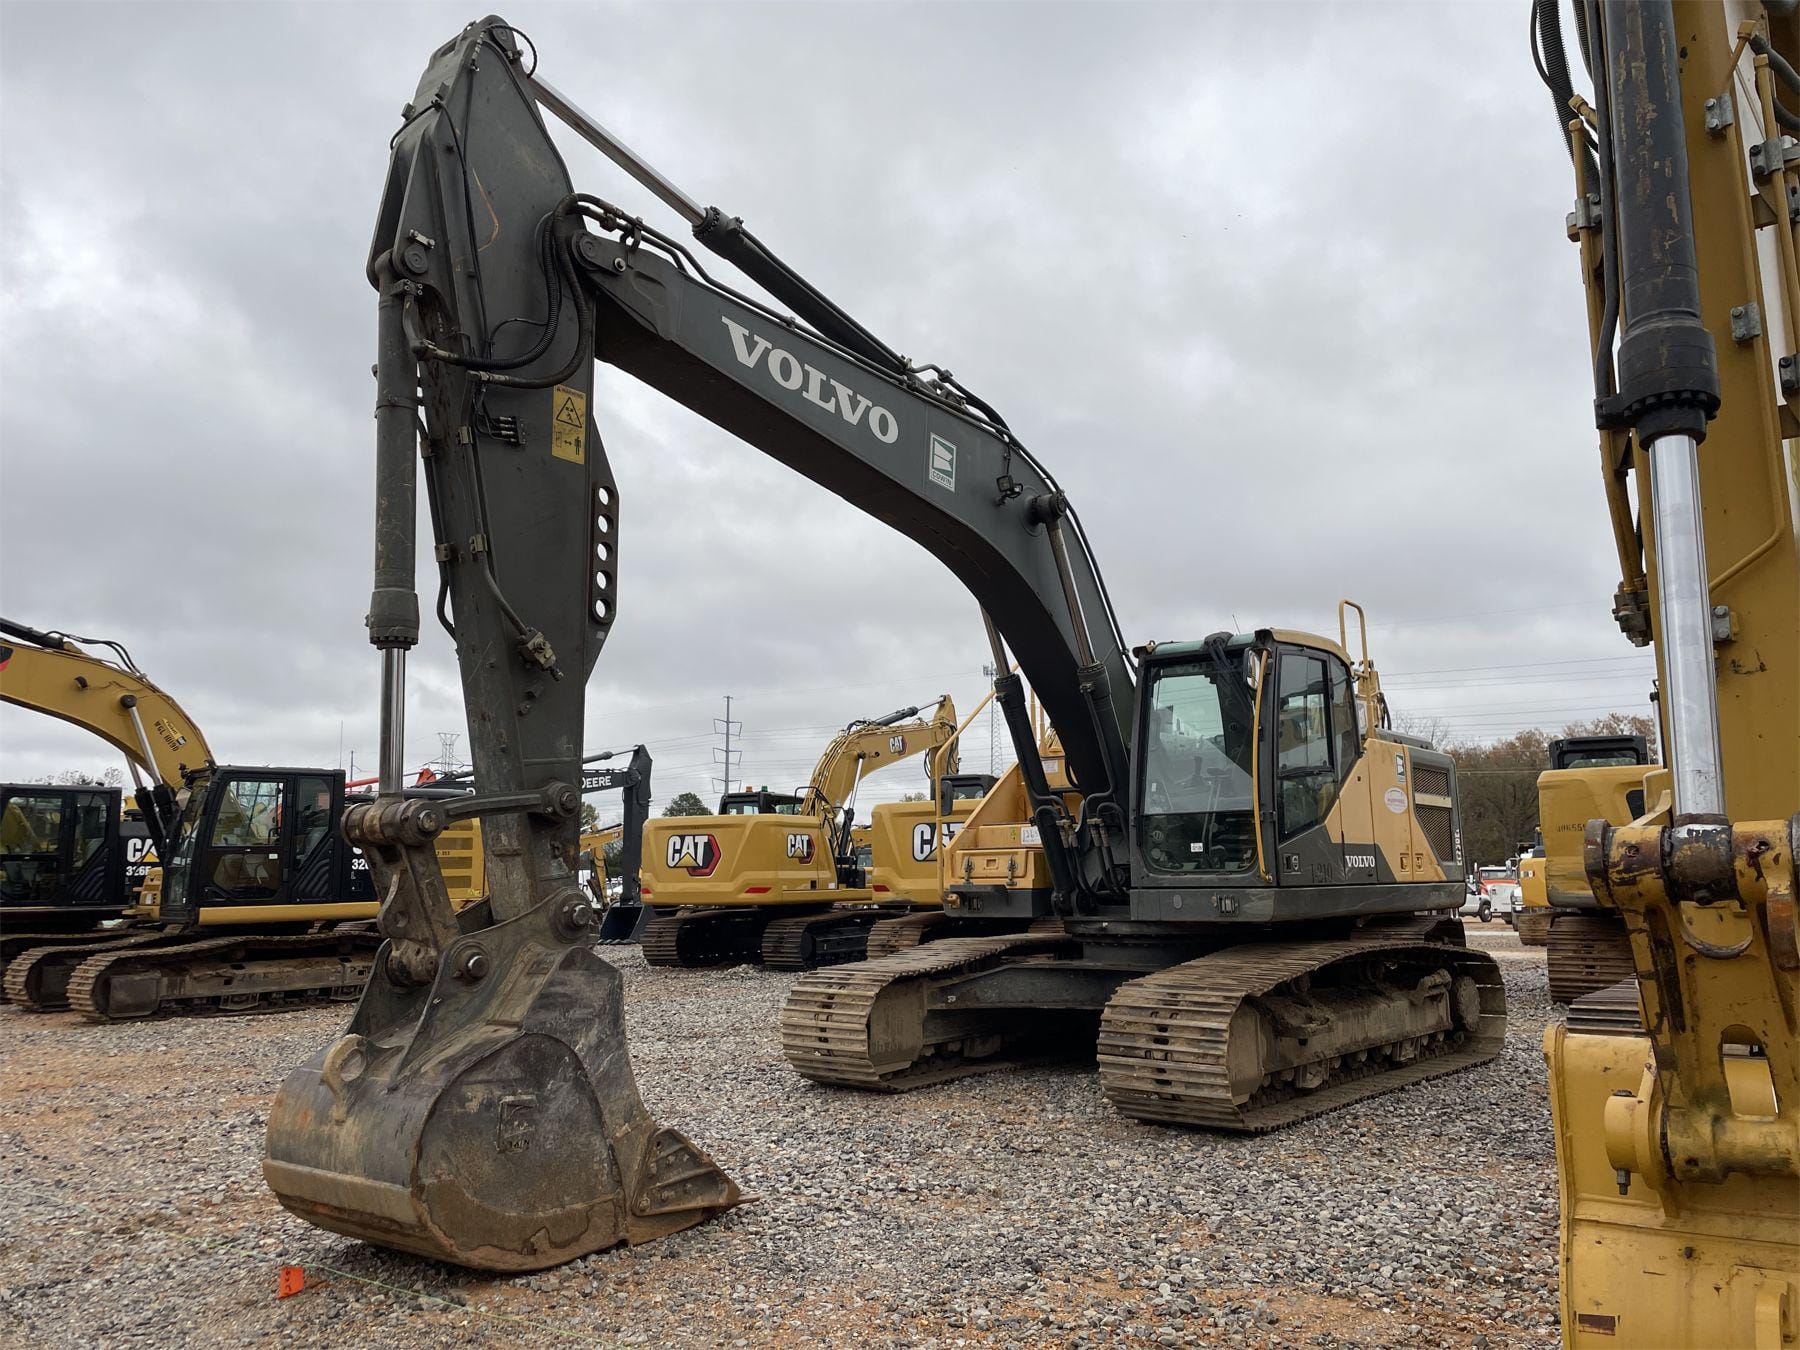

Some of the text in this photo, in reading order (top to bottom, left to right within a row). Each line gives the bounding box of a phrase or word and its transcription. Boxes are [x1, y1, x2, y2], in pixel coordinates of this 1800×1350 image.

[721, 315, 899, 444] VOLVO
[889, 735, 904, 754] CAT
[126, 837, 161, 863] CA
[667, 834, 710, 868] CAT
[787, 834, 809, 858] CAT
[1345, 855, 1376, 868] VOLVO
